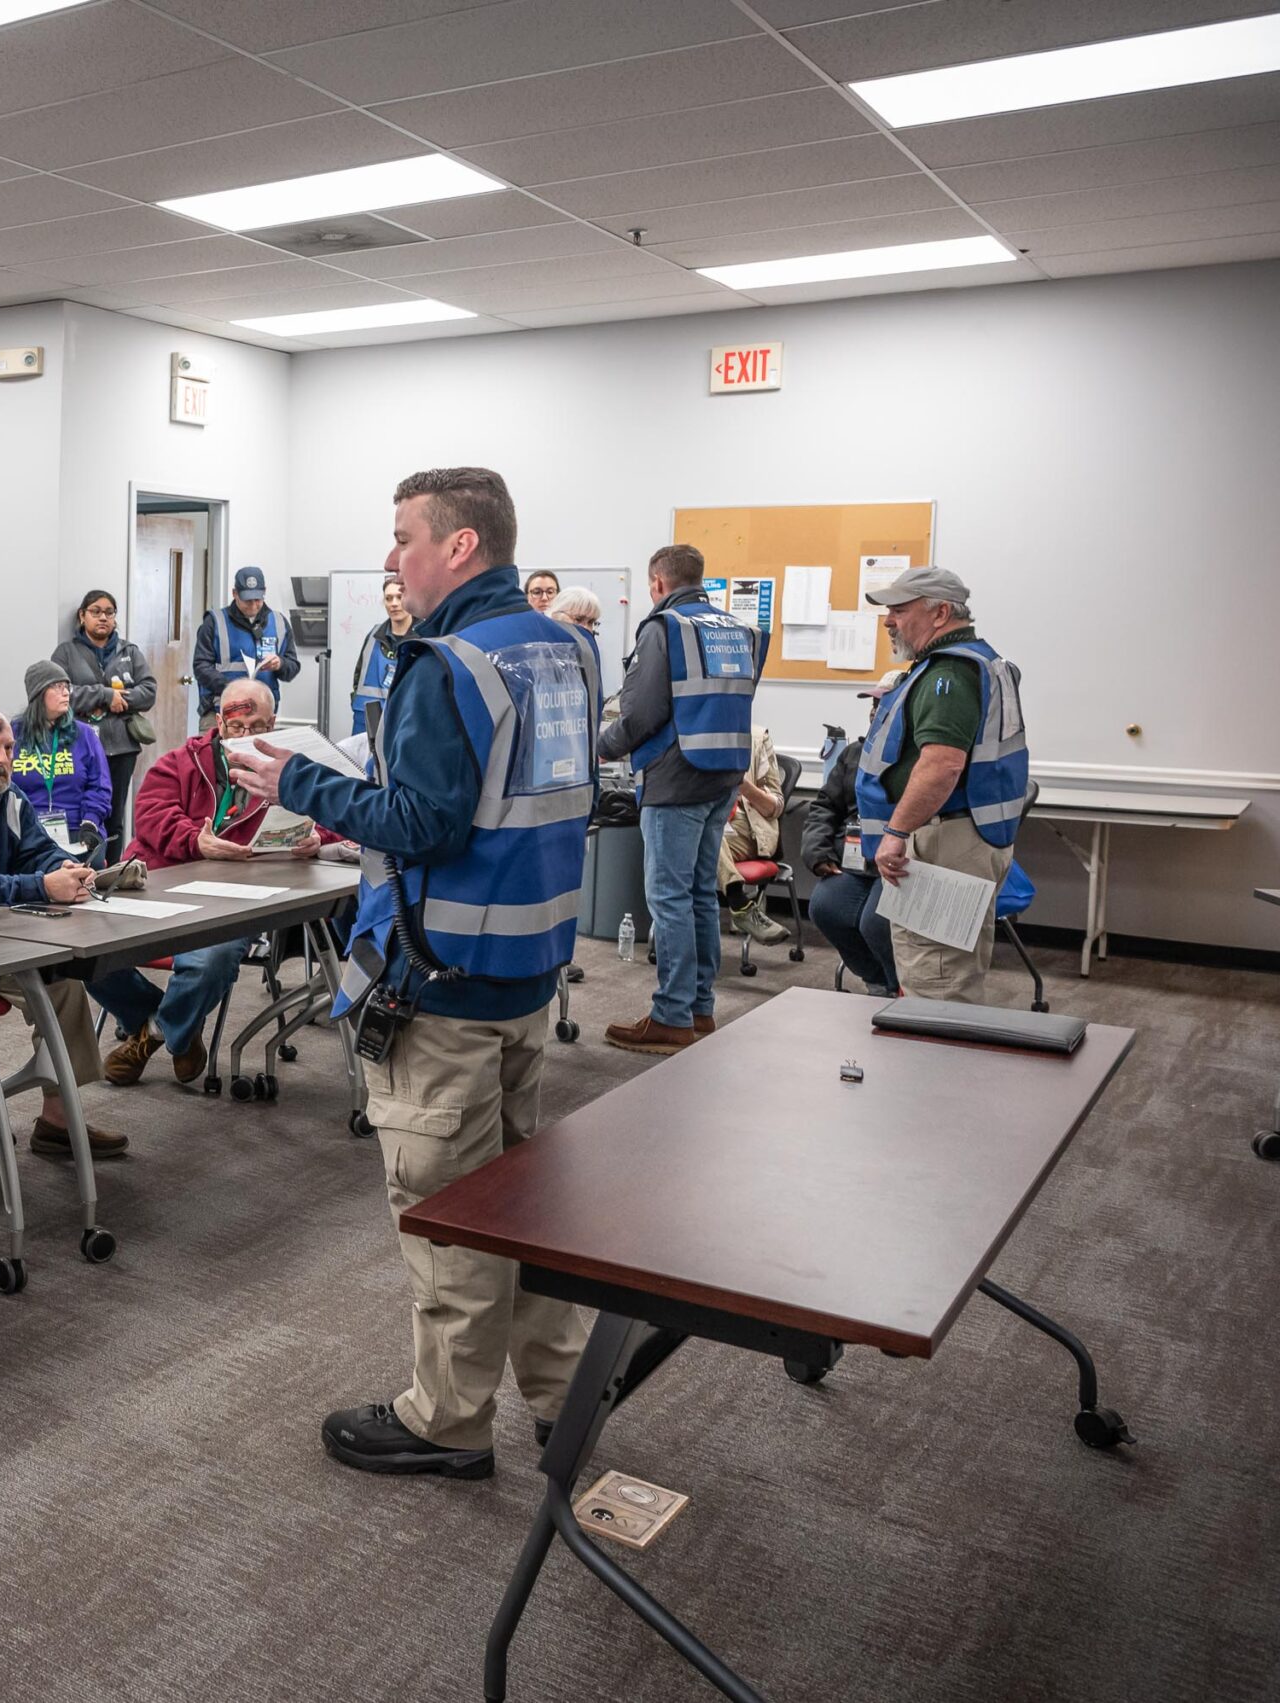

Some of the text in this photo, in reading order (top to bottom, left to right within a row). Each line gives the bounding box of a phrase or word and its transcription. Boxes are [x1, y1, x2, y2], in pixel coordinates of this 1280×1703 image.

[724, 349, 771, 384] EXIT
[184, 386, 208, 417] EXIT
[704, 631, 745, 641] VOLUNTEER
[705, 645, 749, 654] CONTROLLER
[536, 690, 585, 709] VOLUNTEER
[536, 718, 587, 739] CONTROLLER
